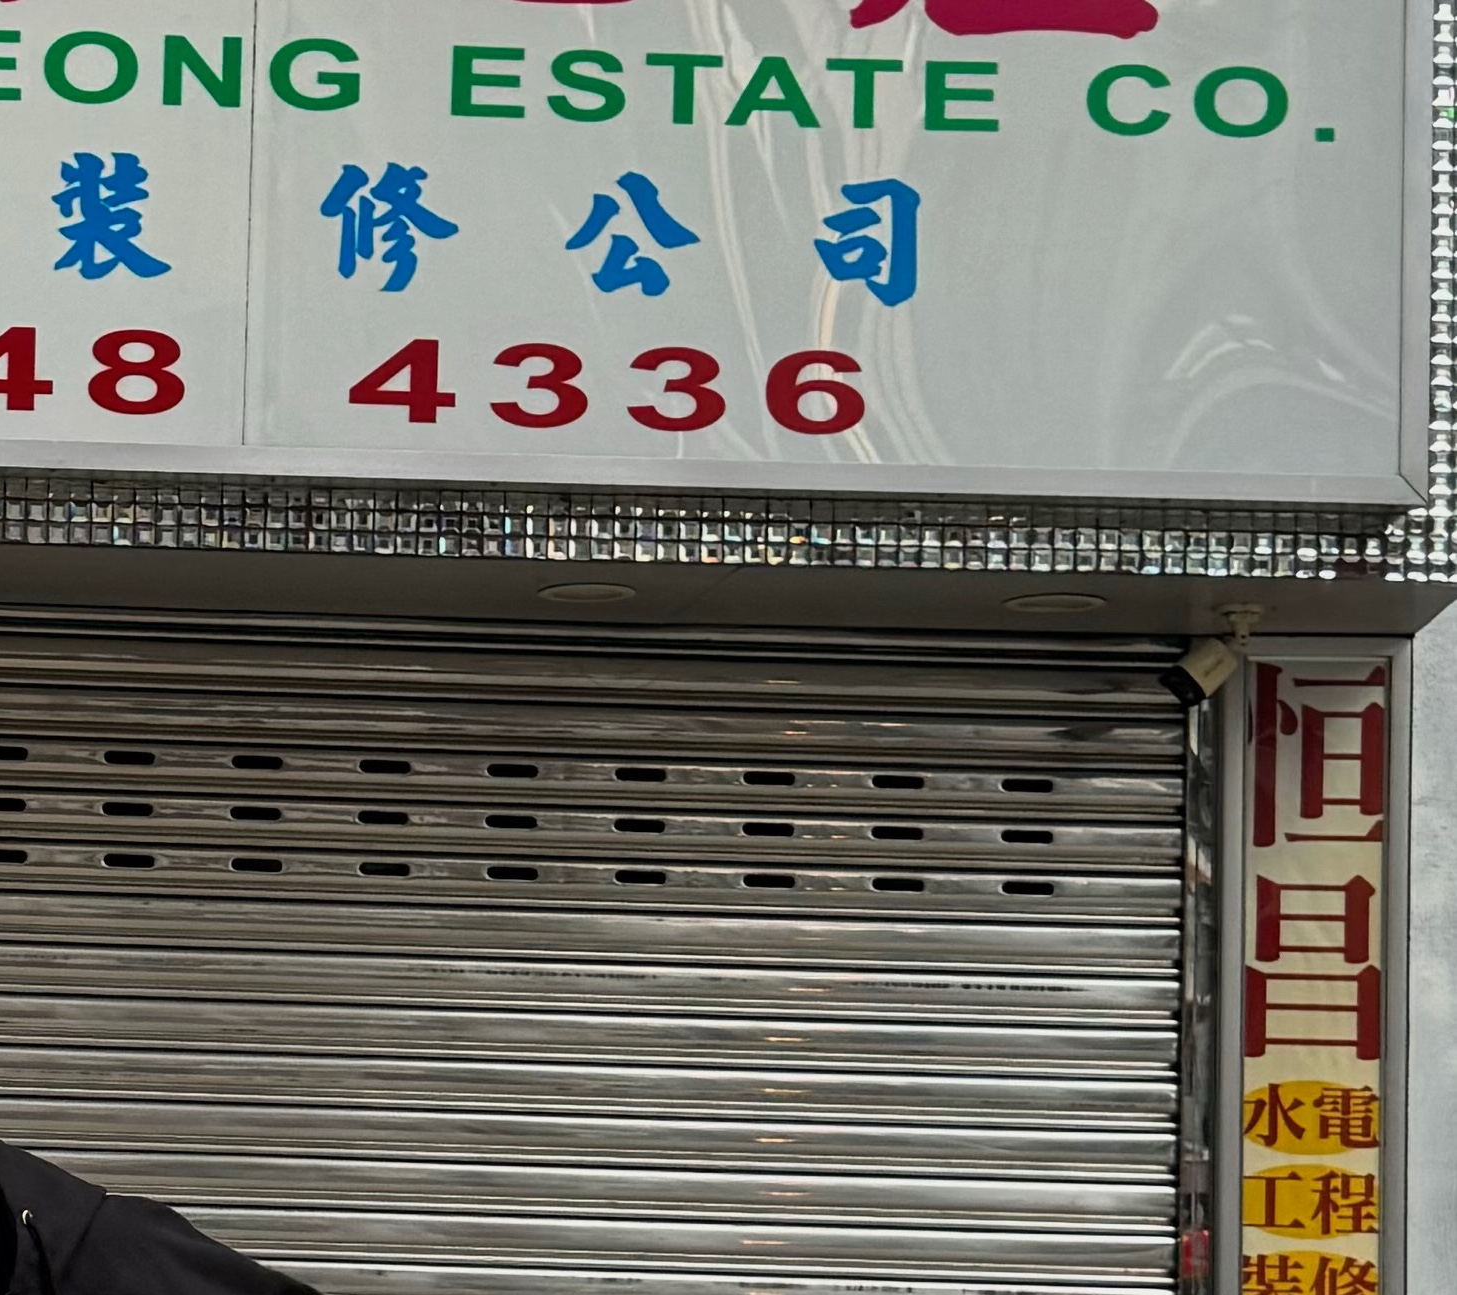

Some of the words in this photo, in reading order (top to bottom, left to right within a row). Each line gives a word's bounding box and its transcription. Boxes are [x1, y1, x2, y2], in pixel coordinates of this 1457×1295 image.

[451, 46, 999, 132] ESTATE
[1086, 65, 1334, 142] CO.
[350, 339, 864, 434] 4336
[1247, 662, 1385, 1061] 恒昌
[1243, 1083, 1380, 1149] 水電
[1243, 1170, 1380, 1235] 工程
